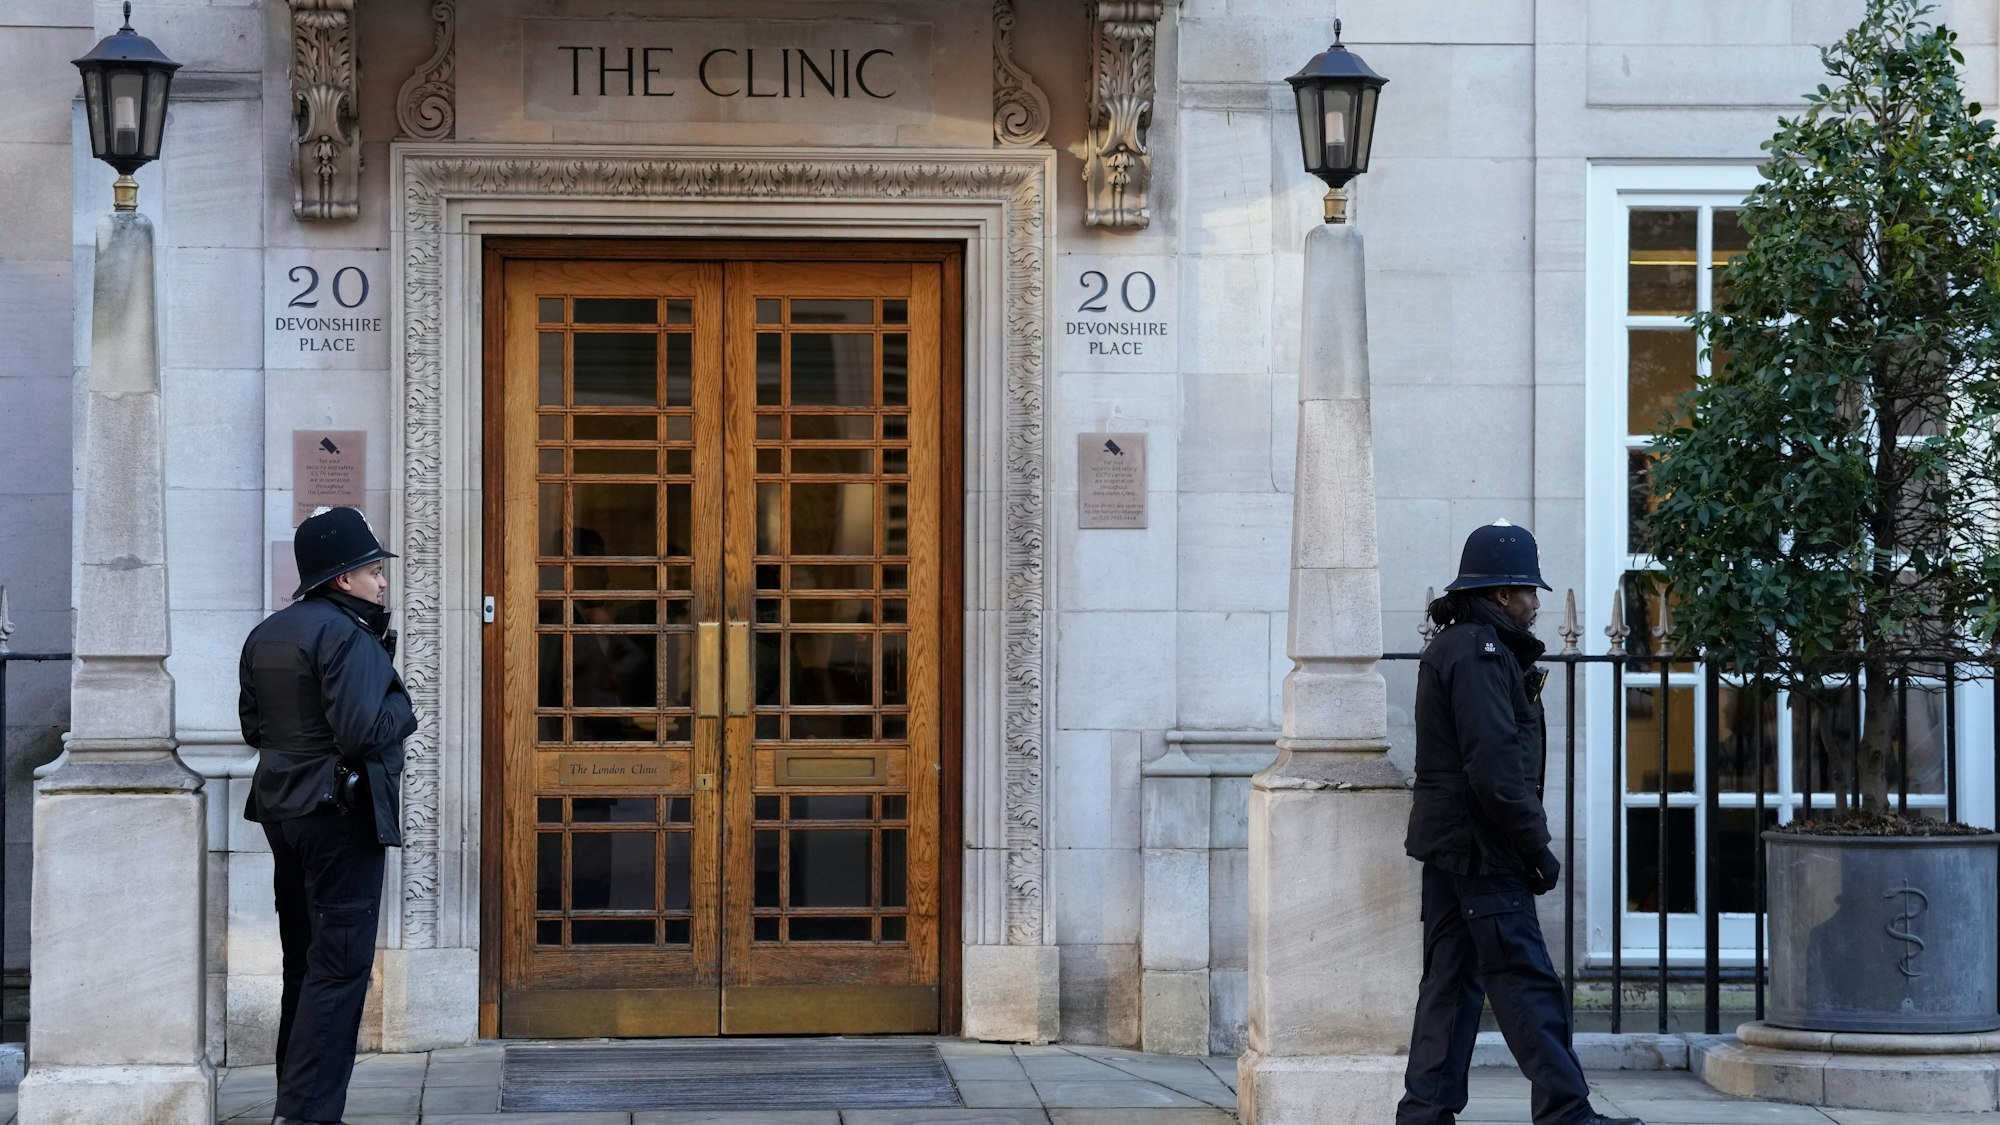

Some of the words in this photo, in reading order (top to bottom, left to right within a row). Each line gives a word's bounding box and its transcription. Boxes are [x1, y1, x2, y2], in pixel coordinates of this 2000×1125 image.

[558, 46, 676, 97] THE
[699, 48, 897, 99] CLINIC
[288, 265, 370, 308] 20
[1077, 270, 1156, 313] 20
[275, 317, 382, 332] DEVONSHIRE
[1066, 322, 1168, 336] DEVONSHIRE
[300, 338, 356, 352] PLACE
[1089, 341, 1143, 355] PLACE
[570, 764, 588, 775] The
[592, 764, 626, 775] London
[631, 764, 658, 775] Clinic
